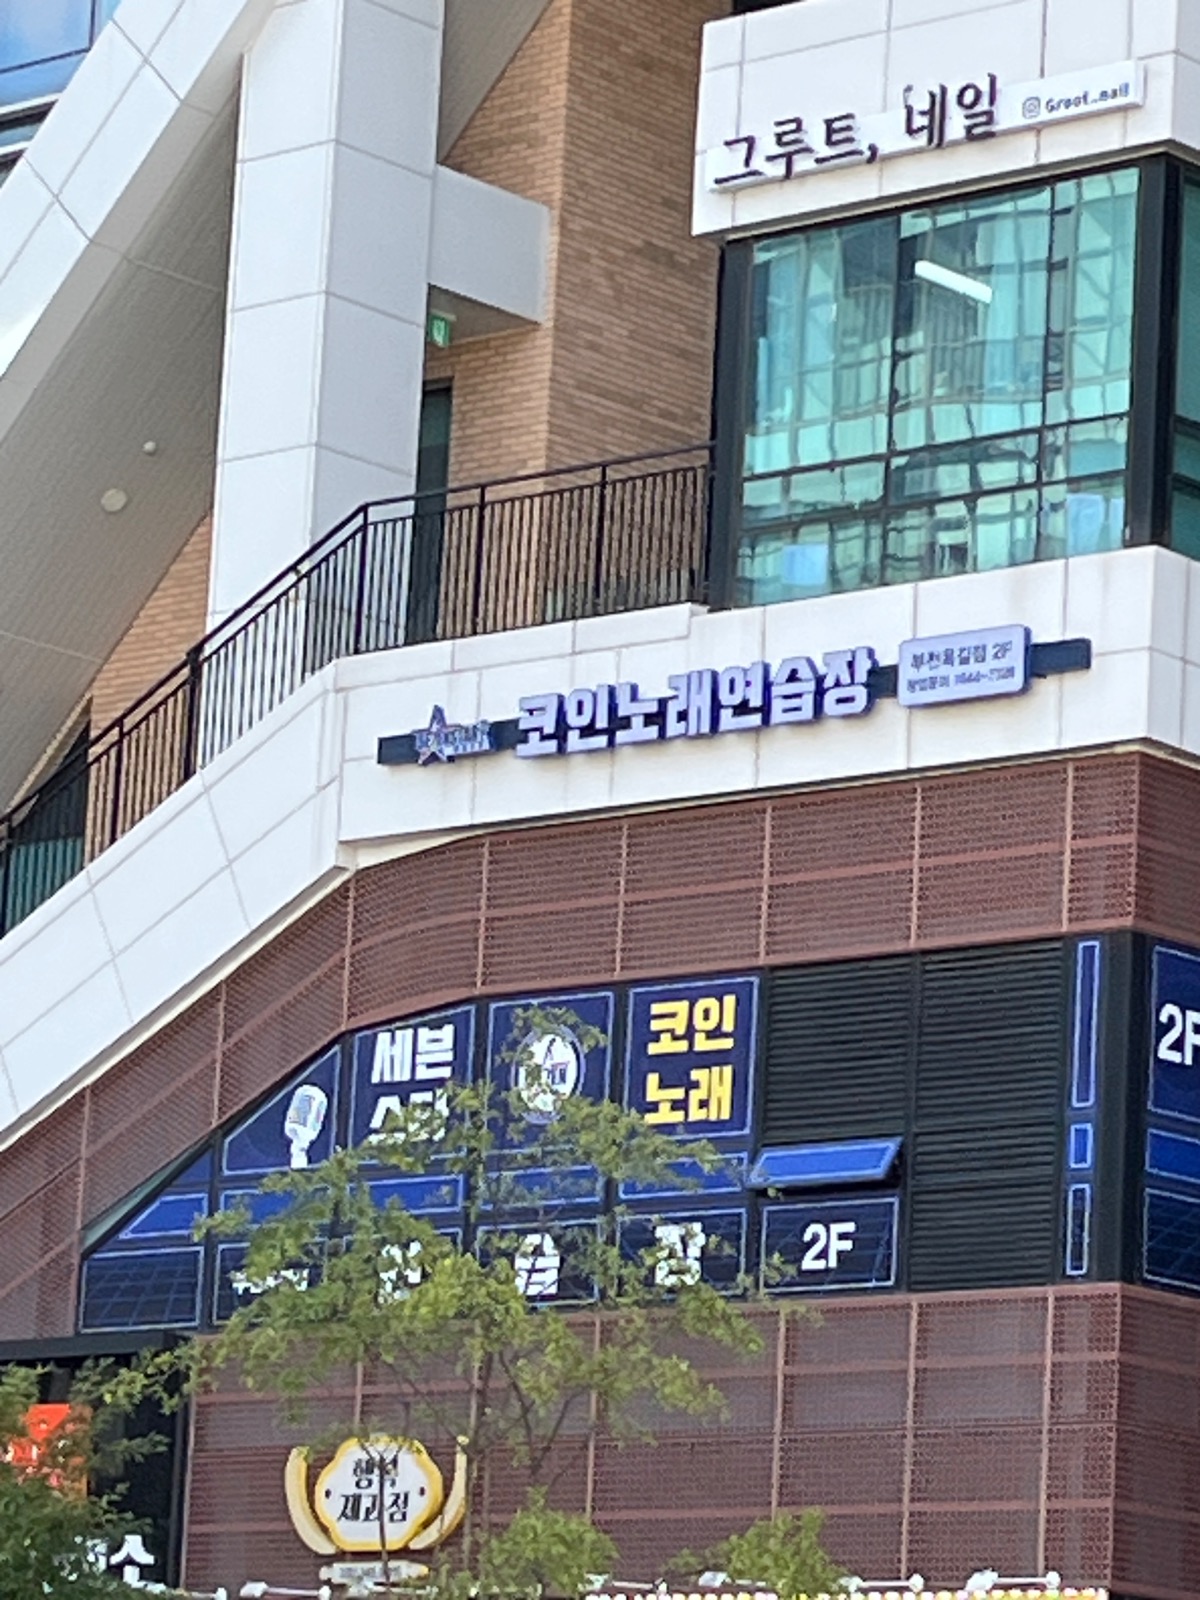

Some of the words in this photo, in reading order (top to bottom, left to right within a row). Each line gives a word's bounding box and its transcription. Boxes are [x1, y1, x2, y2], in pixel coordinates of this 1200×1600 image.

[714, 112, 879, 184] 그루트,
[903, 73, 998, 147] 네일
[516, 646, 878, 758] 코인노래연습장
[371, 1024, 454, 1083] 세븐
[646, 994, 737, 1055] 코인
[1158, 1003, 1200, 1066] 2F
[644, 1064, 734, 1126] 노래
[801, 1222, 856, 1270] 2F
